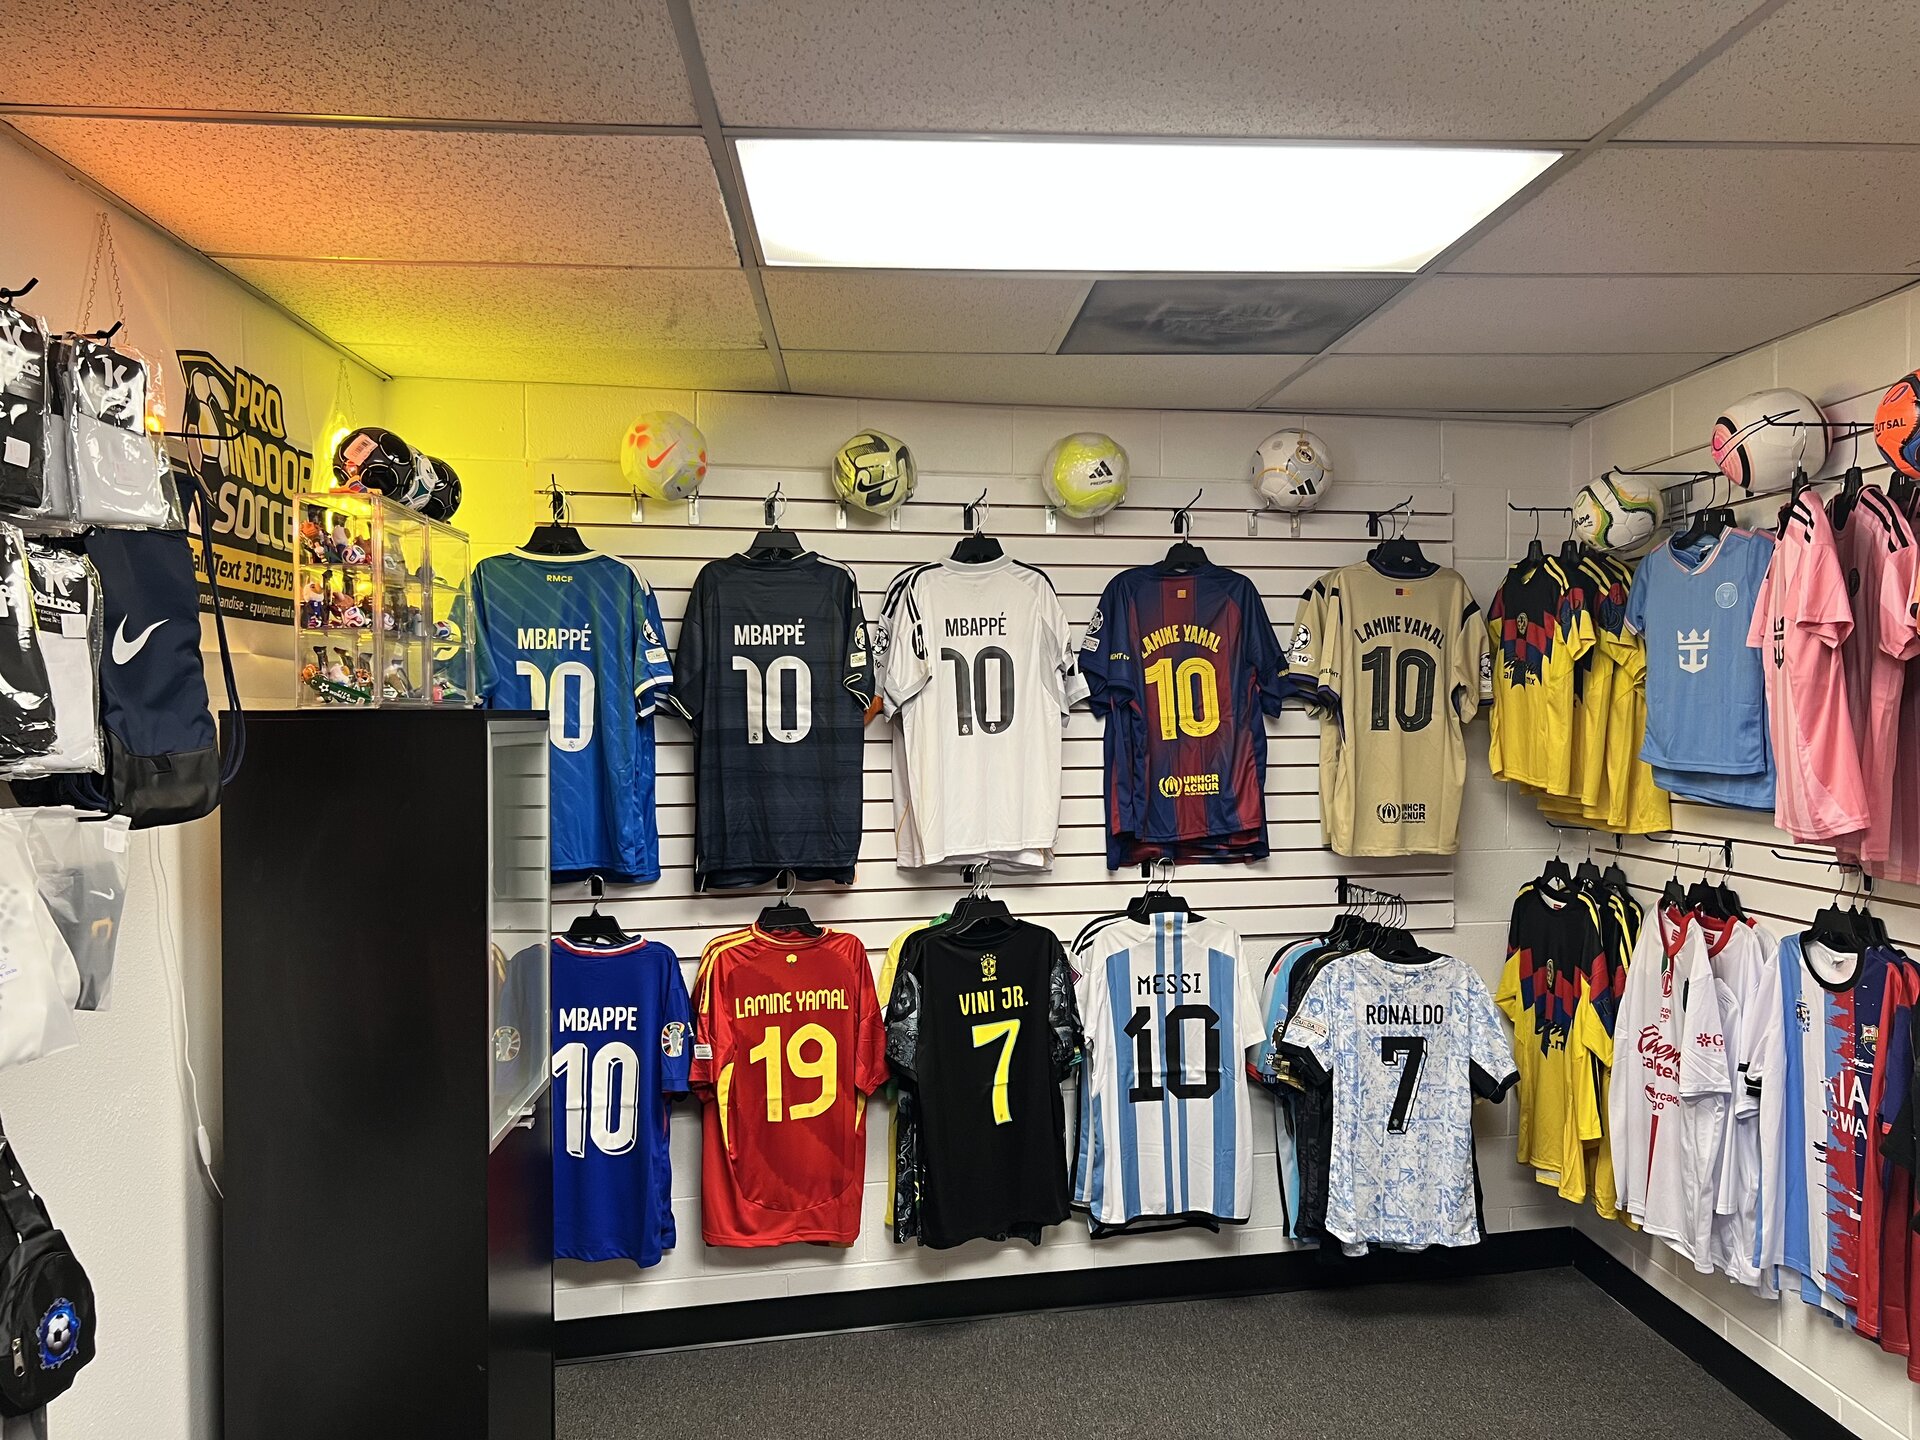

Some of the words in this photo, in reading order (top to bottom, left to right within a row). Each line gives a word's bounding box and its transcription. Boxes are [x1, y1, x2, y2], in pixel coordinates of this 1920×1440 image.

[233, 370, 285, 438] PRO
[226, 422, 313, 500] INDOOR
[212, 481, 295, 552] SOCCE
[243, 561, 294, 591] 310-933-79
[546, 574, 574, 583] RMCF
[199, 594, 244, 610] merandise
[250, 601, 280, 617] equipment
[281, 606, 291, 618] and
[518, 624, 592, 651] MBAPPÉ
[734, 618, 806, 646] MBAPPÉ
[945, 612, 1007, 637] MBAPPÉ
[1354, 616, 1401, 644] LAMINE
[1404, 617, 1446, 650] YAMAL
[1141, 625, 1180, 658] LAMINE
[1183, 624, 1222, 653] YAMAL
[732, 656, 812, 744] 10
[941, 645, 1015, 737] 10
[1145, 657, 1220, 741] 10
[1362, 646, 1437, 733] 10
[516, 661, 595, 752] 10
[1183, 774, 1220, 784] UNHCR
[1184, 783, 1220, 792] ACNUR
[1402, 803, 1426, 811] NHCR
[1402, 811, 1426, 820] CNUR
[1137, 973, 1202, 995] MESSI
[735, 992, 793, 1019] LAMINE
[796, 988, 849, 1012] YAMAL
[958, 989, 996, 1016] VINI
[1001, 985, 1029, 1009] JR.
[1366, 1004, 1444, 1025] RONALDO
[559, 1007, 638, 1032] MBAPPE
[1124, 1004, 1221, 1103] 10
[750, 1022, 838, 1122] 19
[971, 1018, 1021, 1126] 7
[1381, 1036, 1428, 1135] 7
[551, 1041, 640, 1158] 10
